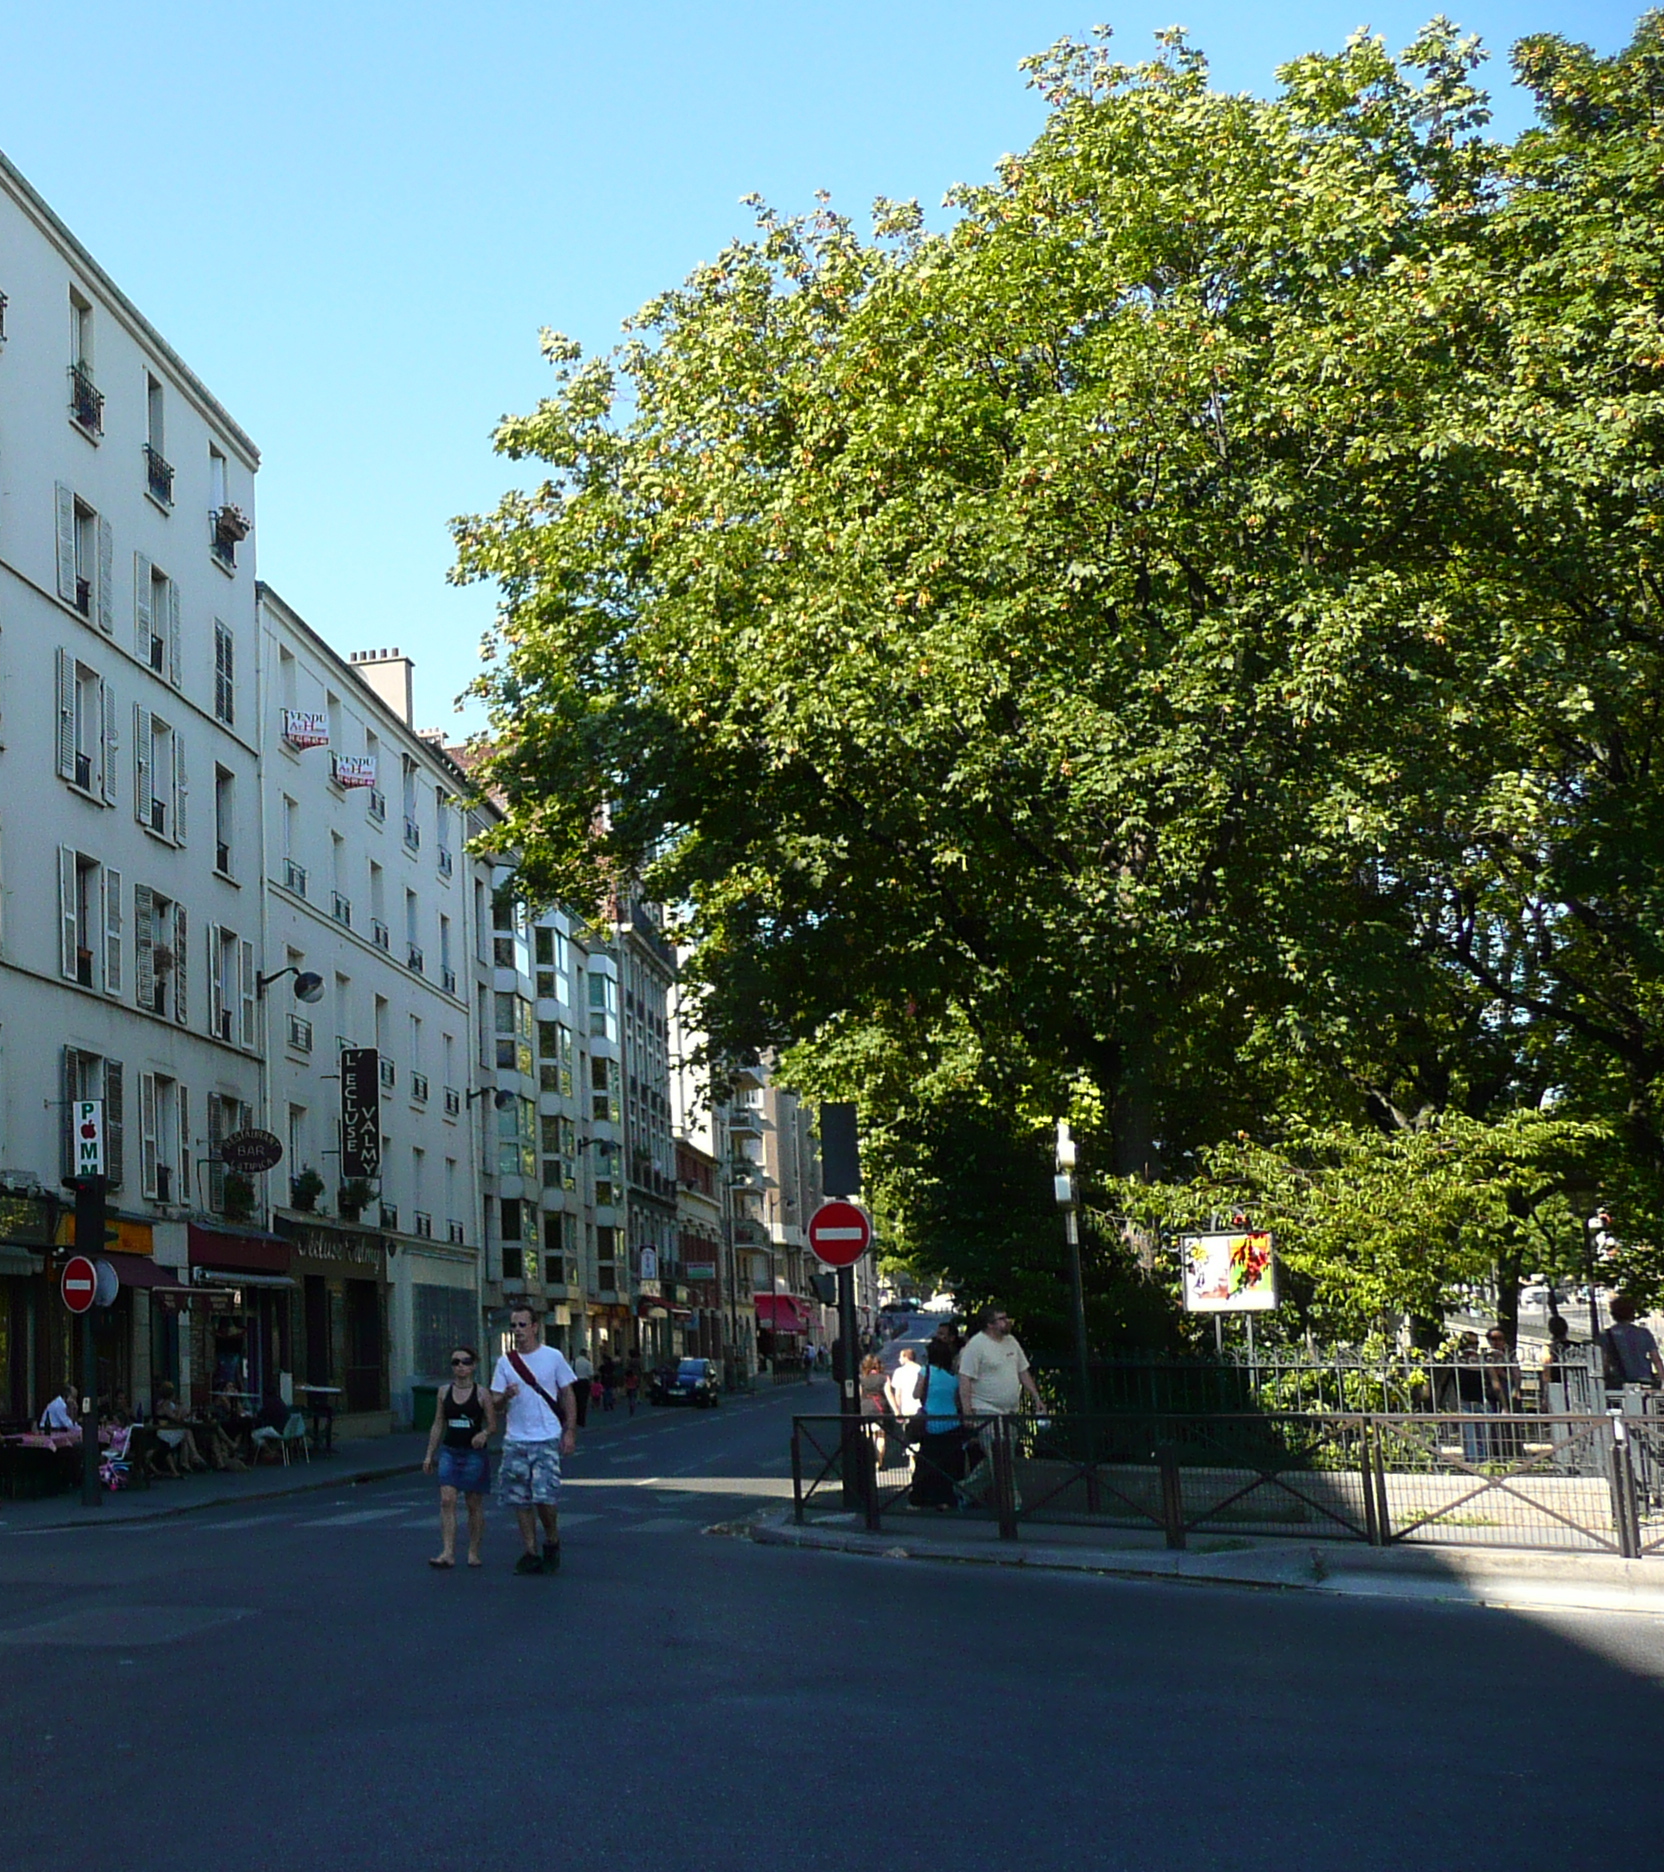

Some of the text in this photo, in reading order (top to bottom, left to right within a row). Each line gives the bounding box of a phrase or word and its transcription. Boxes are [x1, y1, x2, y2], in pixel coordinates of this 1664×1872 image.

[290, 711, 326, 723] VENDU
[339, 756, 373, 766] VENDU
[224, 1130, 280, 1149] RESTAURANT
[360, 1106, 377, 1175] VALMY
[237, 1145, 265, 1157] BAR
